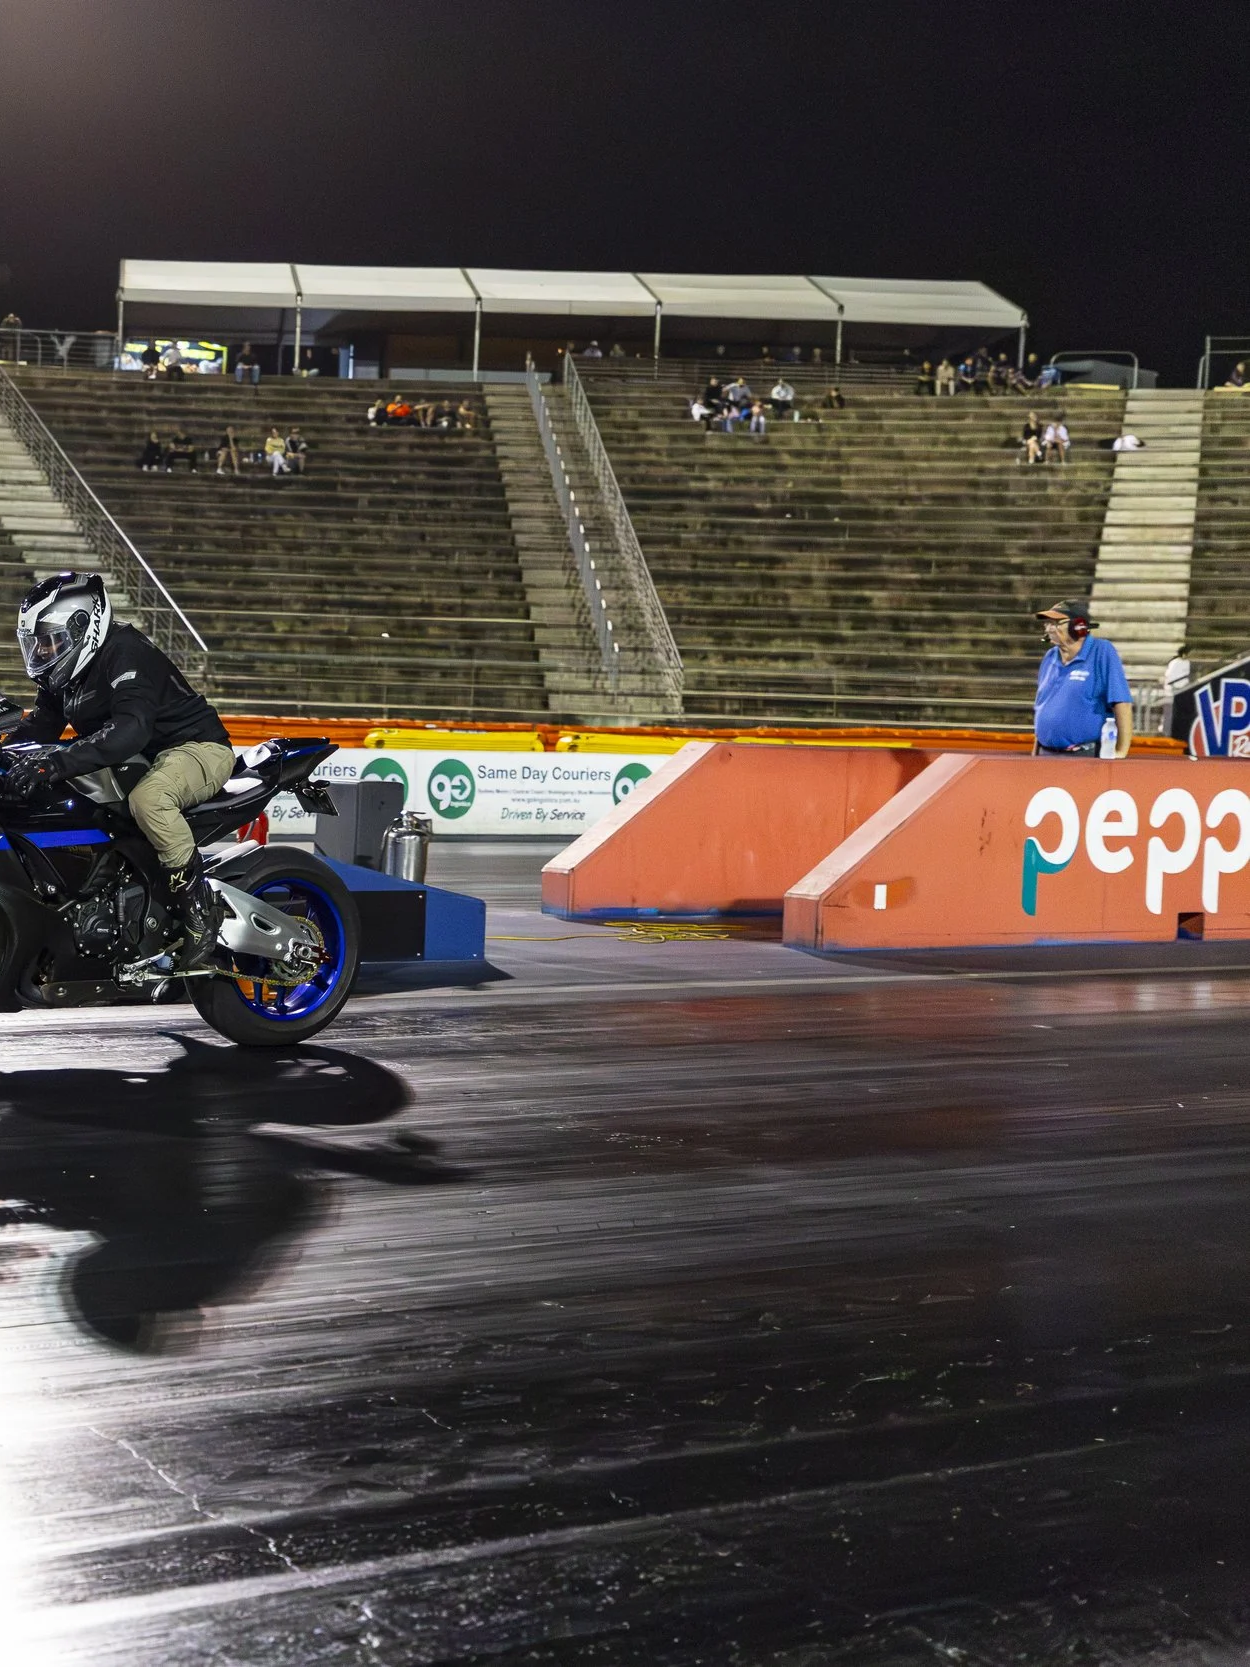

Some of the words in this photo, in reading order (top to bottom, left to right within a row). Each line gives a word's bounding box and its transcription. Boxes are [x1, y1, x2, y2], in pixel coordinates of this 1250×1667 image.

[90, 597, 103, 653] SHARK
[477, 765, 517, 779] Same
[522, 767, 548, 783] Day
[552, 767, 611, 781] Couriers
[272, 805, 287, 822] By
[501, 808, 533, 820] Driven
[535, 807, 549, 821] By
[550, 809, 586, 821] Service
